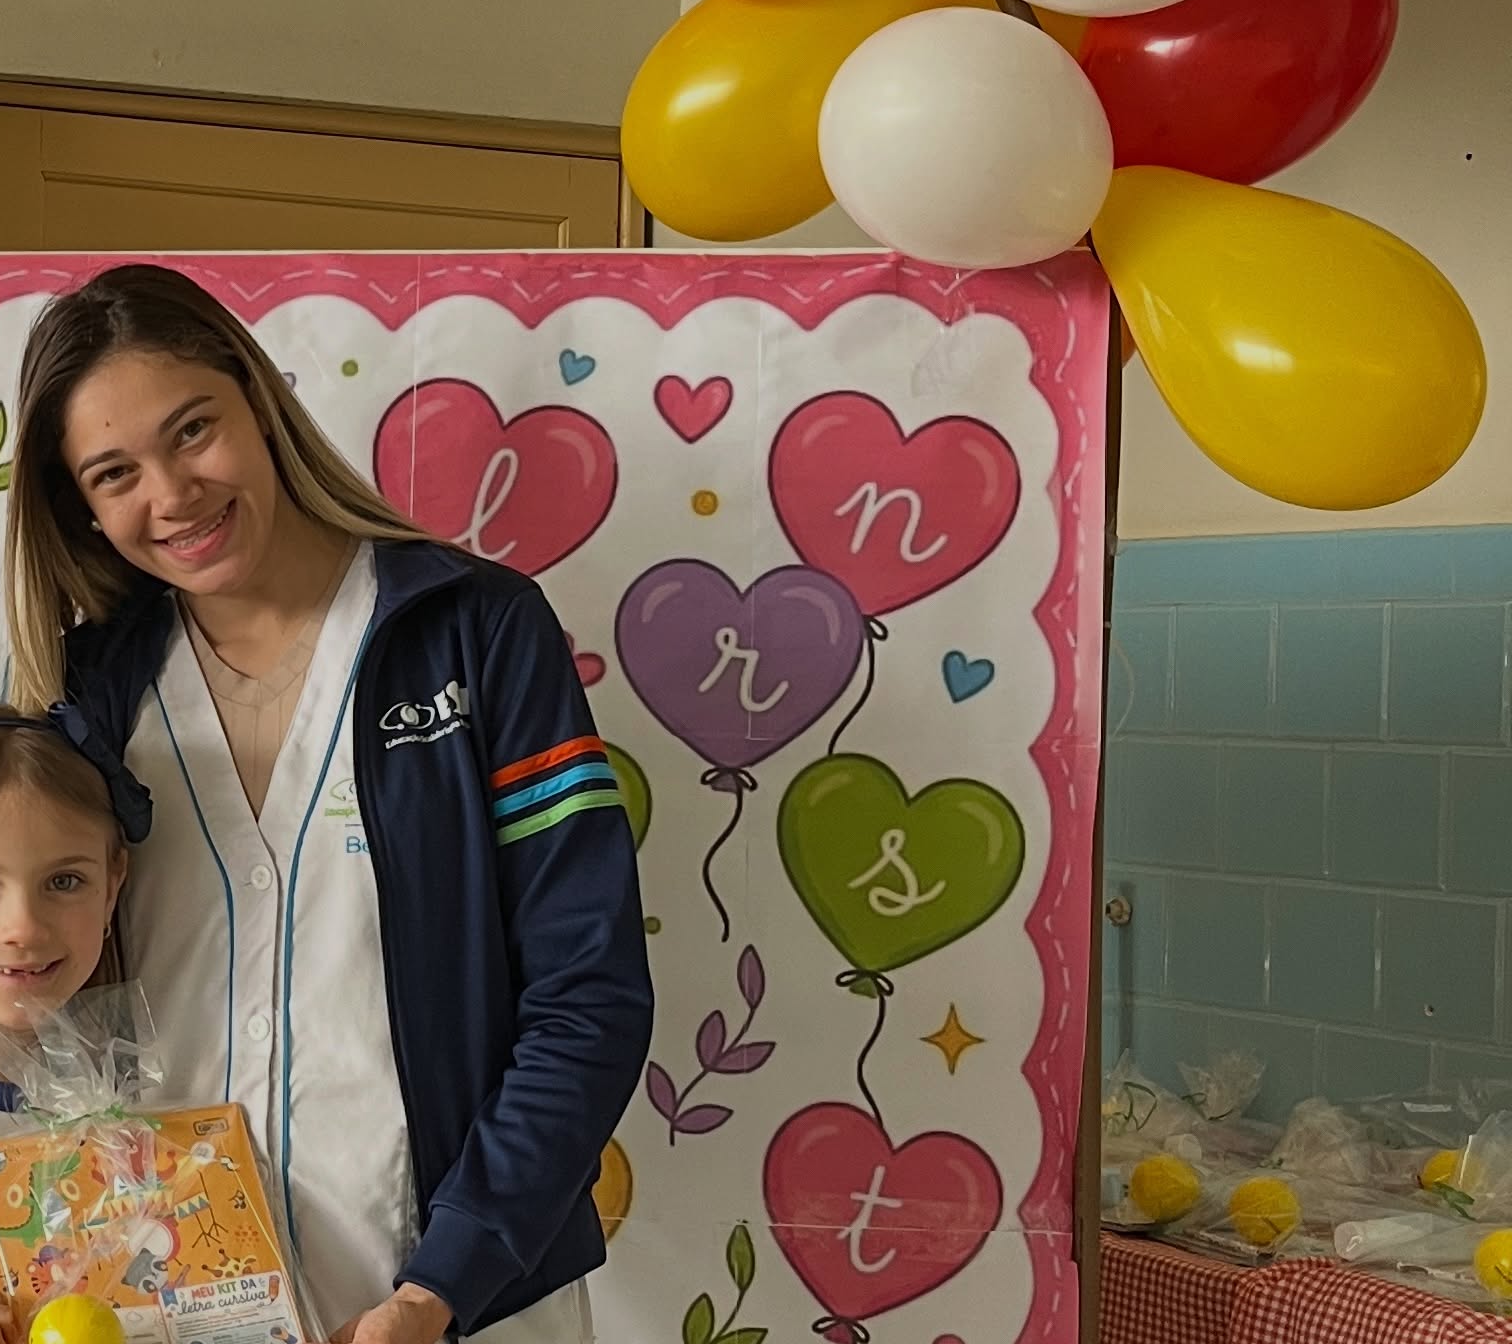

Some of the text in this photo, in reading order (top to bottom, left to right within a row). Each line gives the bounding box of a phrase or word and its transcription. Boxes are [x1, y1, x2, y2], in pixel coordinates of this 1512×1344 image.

[834, 481, 948, 563] n
[698, 627, 789, 713] r
[837, 1165, 902, 1274] t
[177, 1290, 269, 1315] letra cursiva
[191, 1278, 257, 1299] MEU KIT DA
